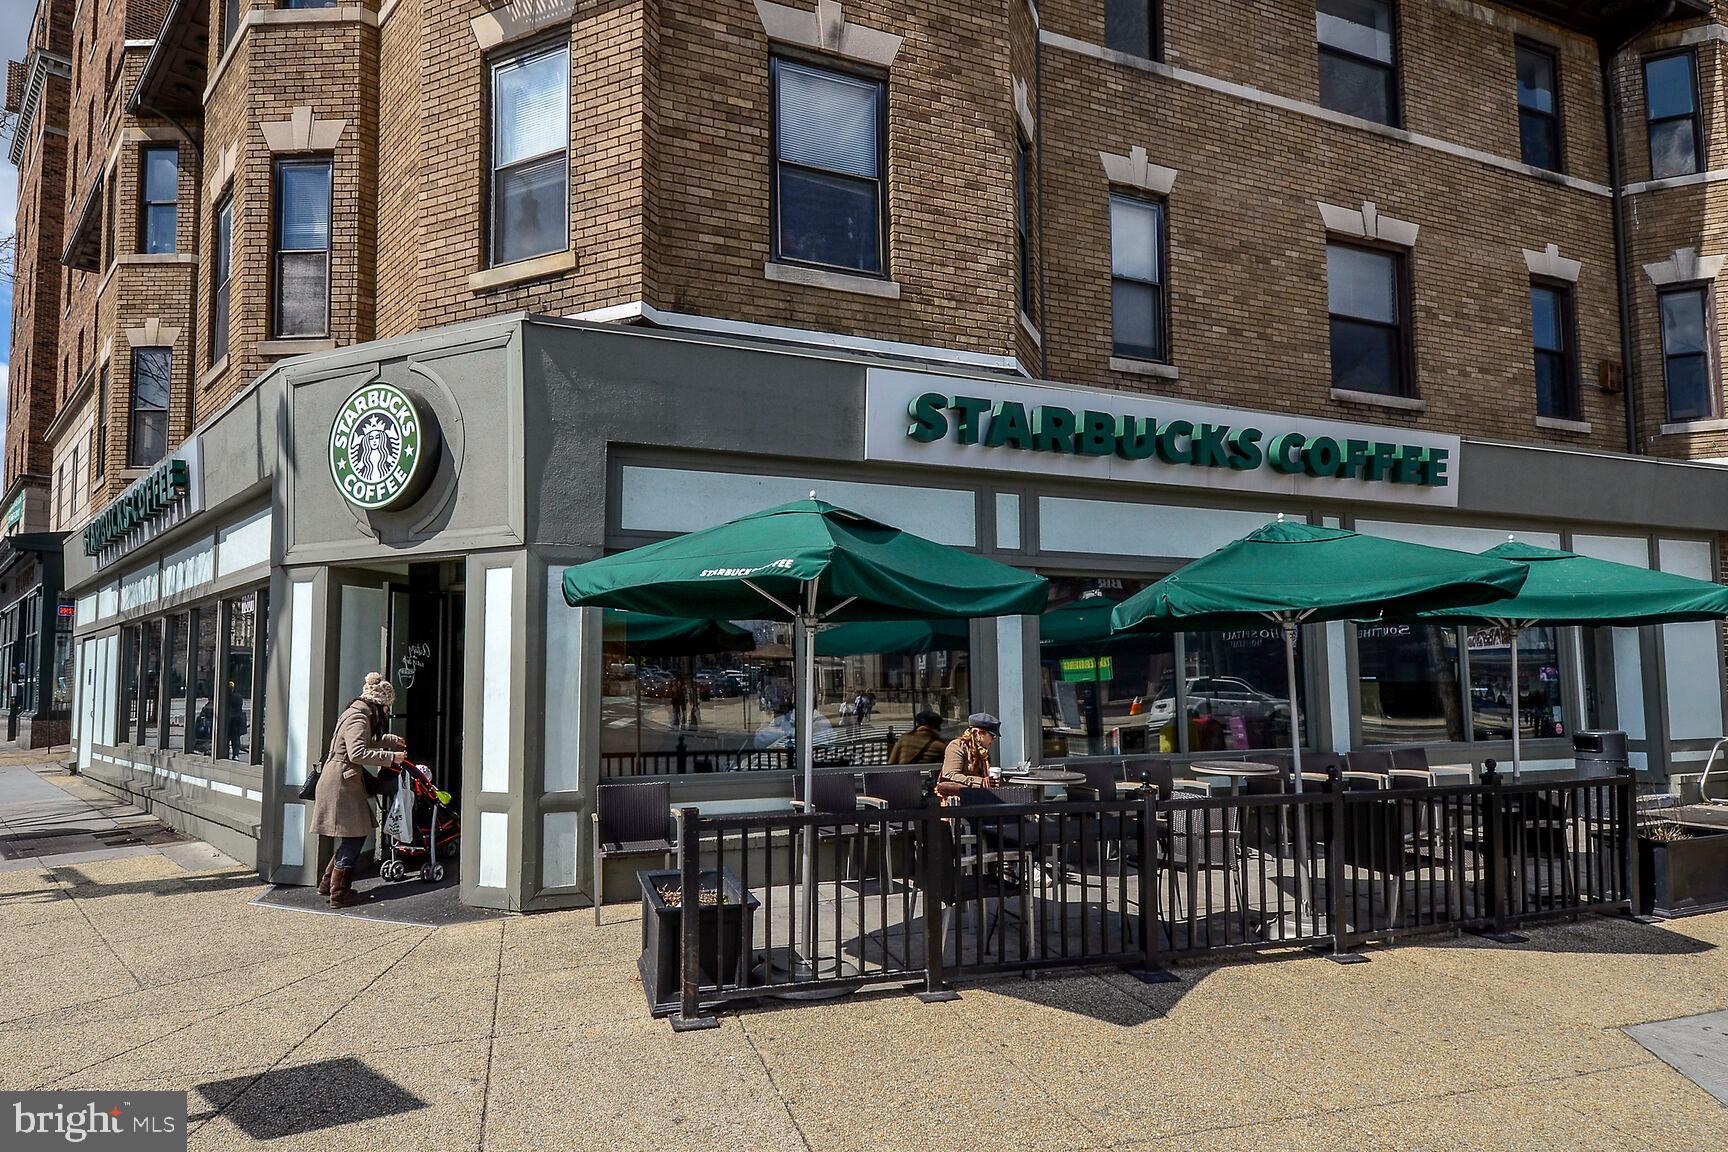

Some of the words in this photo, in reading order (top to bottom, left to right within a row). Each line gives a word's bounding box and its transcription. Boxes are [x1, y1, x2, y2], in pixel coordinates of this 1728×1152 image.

[334, 390, 415, 449] STARBUCKS
[907, 392, 1263, 470] STARBUCKS
[1269, 432, 1449, 487] COFFEE
[343, 465, 408, 502] COFFEE
